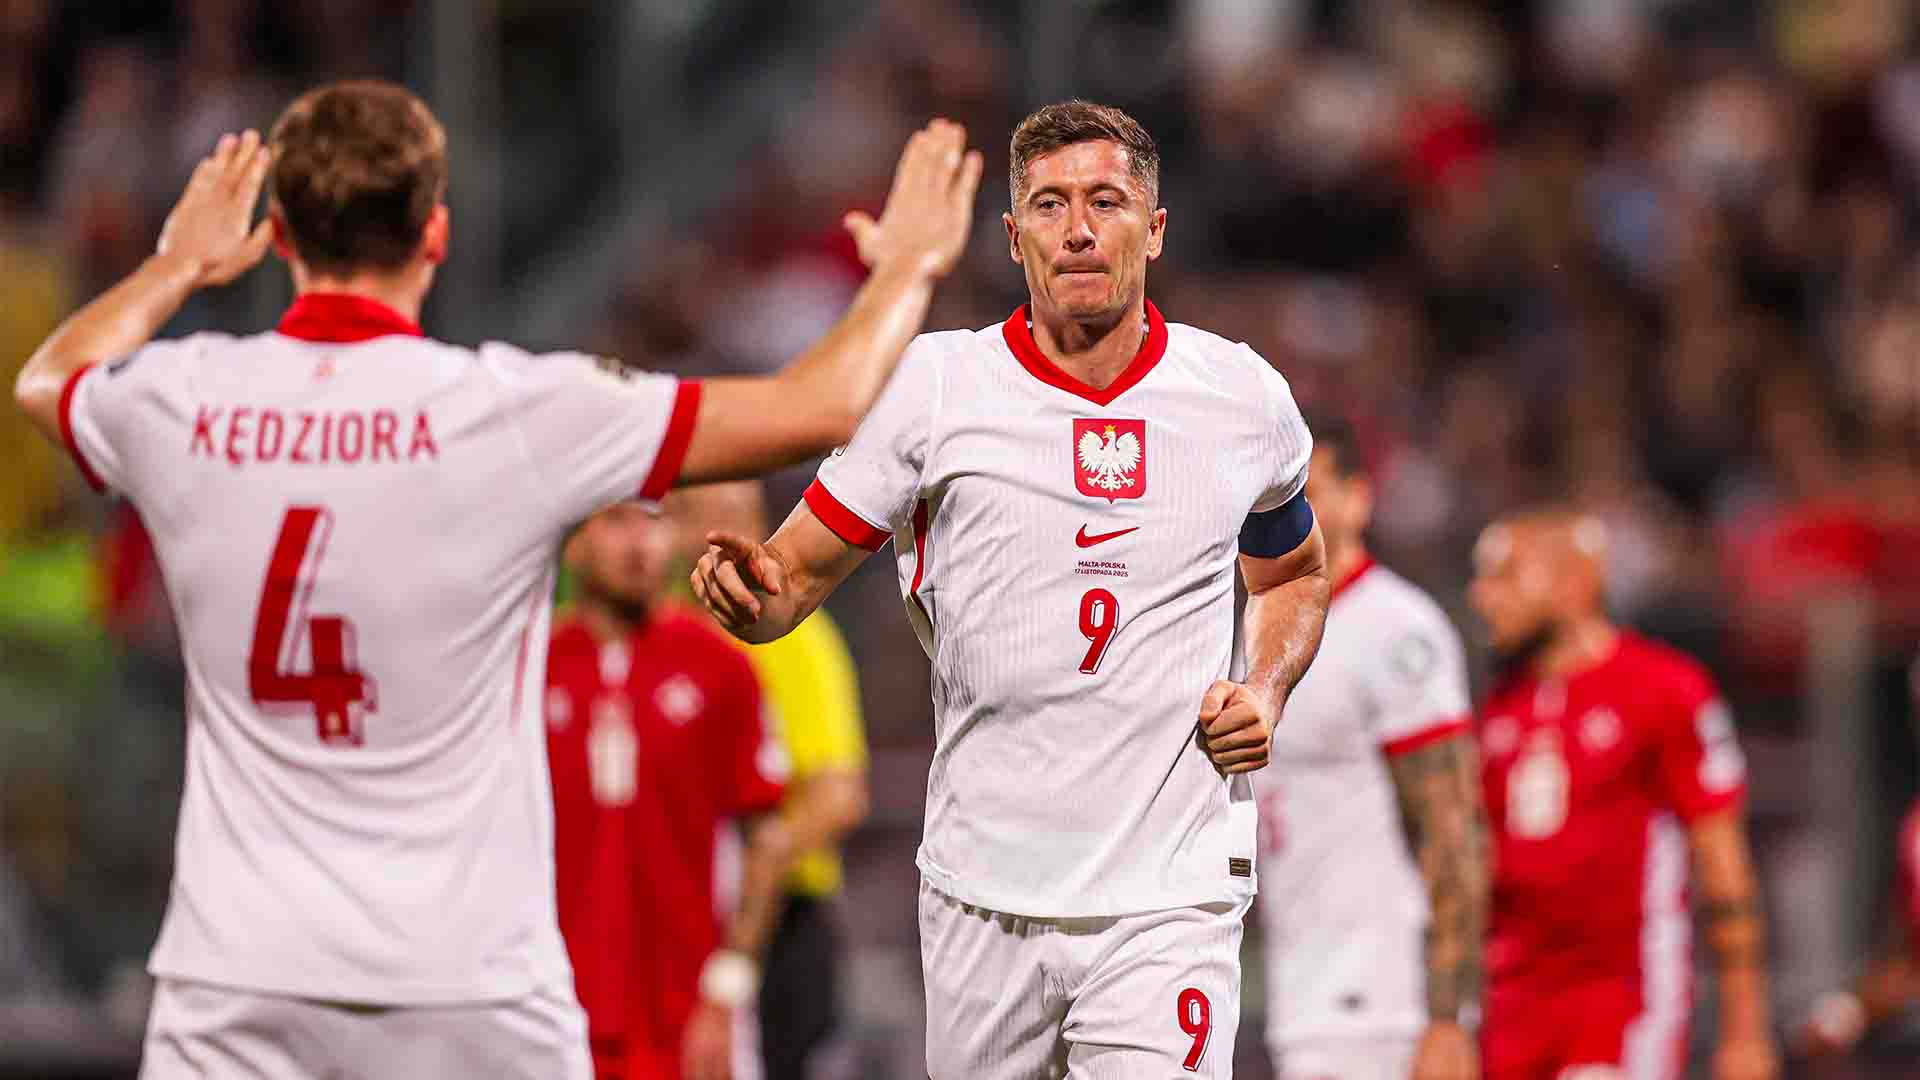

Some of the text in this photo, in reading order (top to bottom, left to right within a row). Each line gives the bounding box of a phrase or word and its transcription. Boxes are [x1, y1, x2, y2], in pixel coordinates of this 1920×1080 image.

[190, 404, 439, 467] KĘDZIORA
[1078, 560, 1126, 569] MALTA-POLSKA
[1081, 568, 1112, 576] LISTOPADA
[248, 506, 378, 747] 4
[1079, 588, 1120, 674] 9
[1177, 988, 1213, 1072] 9
